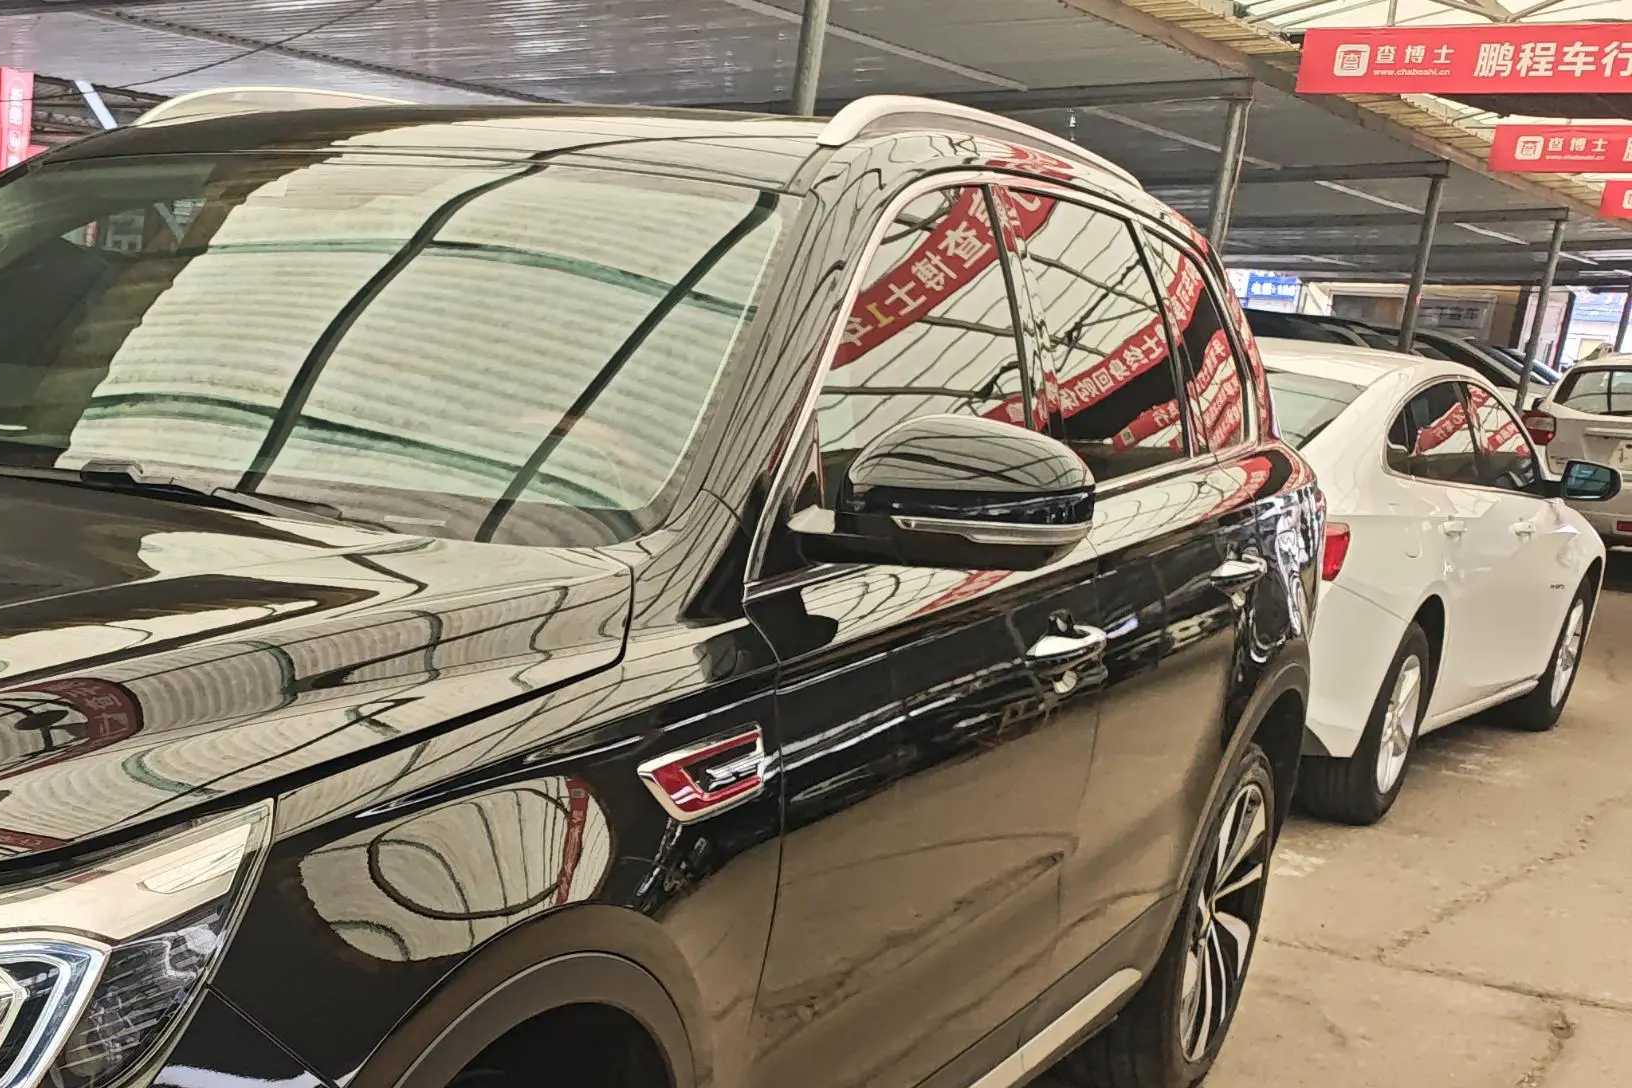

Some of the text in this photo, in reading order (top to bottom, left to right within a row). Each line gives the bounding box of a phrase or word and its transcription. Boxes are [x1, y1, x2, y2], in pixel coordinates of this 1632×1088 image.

[1375, 45, 1454, 64] 查博士
[1473, 41, 1632, 77] 鹏程车行
[1373, 68, 1450, 76] www.chaboshi.cn
[1547, 137, 1608, 152] 查博士
